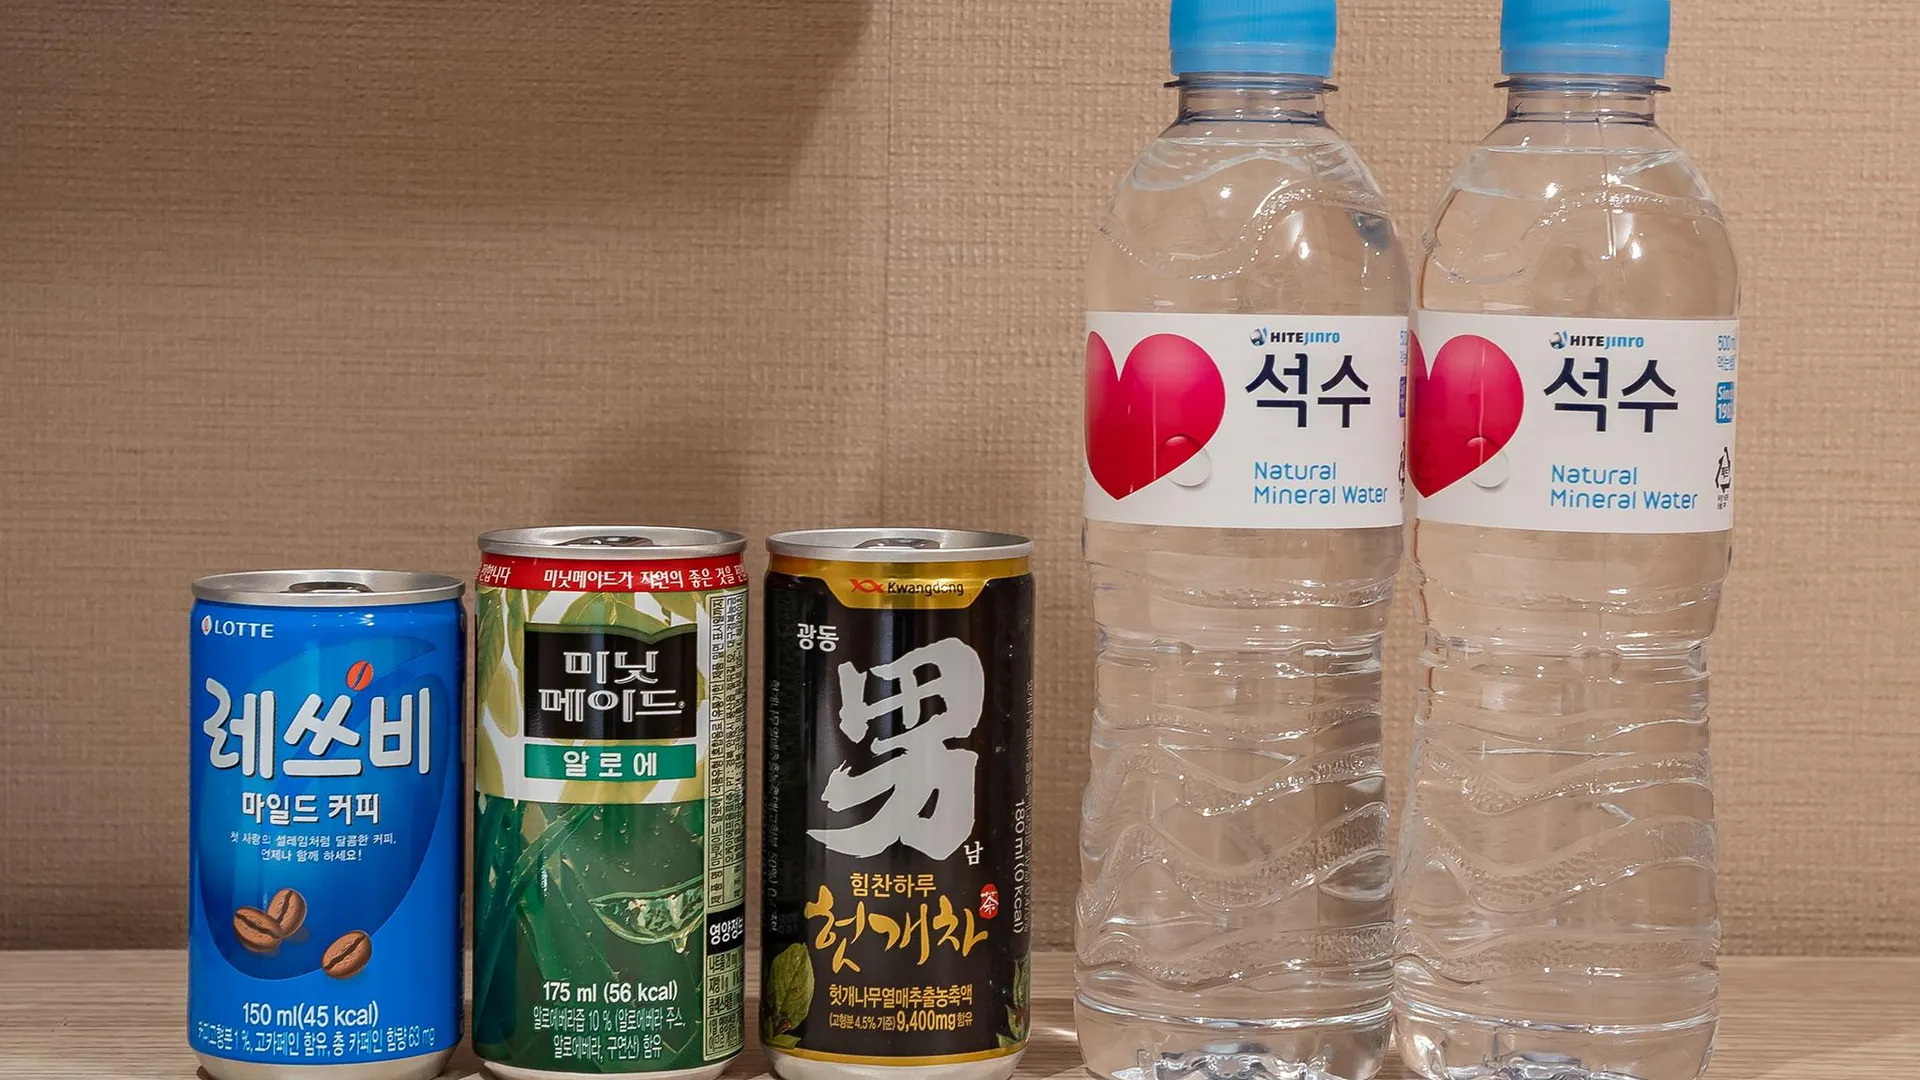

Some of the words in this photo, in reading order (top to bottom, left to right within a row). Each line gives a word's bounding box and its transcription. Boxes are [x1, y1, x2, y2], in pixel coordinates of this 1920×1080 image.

[1245, 353, 1371, 428] 석수
[1543, 357, 1678, 433] 석수
[1254, 461, 1336, 481] Natural
[1551, 465, 1637, 485] Natural
[1254, 485, 1336, 505] Mineral
[1341, 485, 1387, 505] Water
[1550, 489, 1636, 510] Mineral
[1643, 491, 1698, 510] Water
[543, 569, 634, 589] 미닛메이드가
[640, 570, 684, 589] 자연의
[688, 568, 713, 588] 좋은
[715, 566, 735, 585] 것을
[887, 580, 965, 597] Kwangdong
[214, 619, 274, 639] LOTTE
[797, 623, 839, 652] 광동
[563, 650, 659, 685] 미닛
[538, 688, 683, 723] 메이드
[203, 678, 431, 779] 레쓰비
[806, 637, 985, 861] 男
[563, 751, 658, 777] 알로에
[242, 792, 319, 827] 마일드
[328, 793, 381, 826] 커피
[1015, 799, 1025, 833] 180
[229, 830, 239, 844] 첫
[242, 832, 271, 846] 사랑의
[276, 834, 331, 848] 설레임처럼
[335, 834, 369, 848] 달콤한
[261, 849, 292, 862] 언제나
[296, 849, 319, 863] 함께
[323, 849, 362, 862] 하세요!
[964, 841, 984, 865] 남
[850, 873, 937, 898] 힘찬하루
[1013, 885, 1025, 934] kcal)
[804, 885, 988, 974] 헛개차
[543, 981, 570, 1002] 175
[577, 982, 597, 1002] ml
[603, 981, 632, 1004] (56
[638, 979, 678, 1003] kcal)
[829, 983, 973, 1009] 헛개나무열매추출농축액
[243, 1002, 272, 1025] 150
[335, 1000, 379, 1027] kcal)
[533, 1005, 585, 1032] 알로에베라즙
[588, 1009, 599, 1031] 10
[602, 1009, 612, 1031] %
[615, 1007, 663, 1032] (알로에베라
[896, 1009, 956, 1033] 9,400mg
[957, 1011, 974, 1028] 함유
[553, 1034, 603, 1062] 알로에베라,
[606, 1035, 640, 1060] 구연산)
[643, 1034, 663, 1058] 함유
